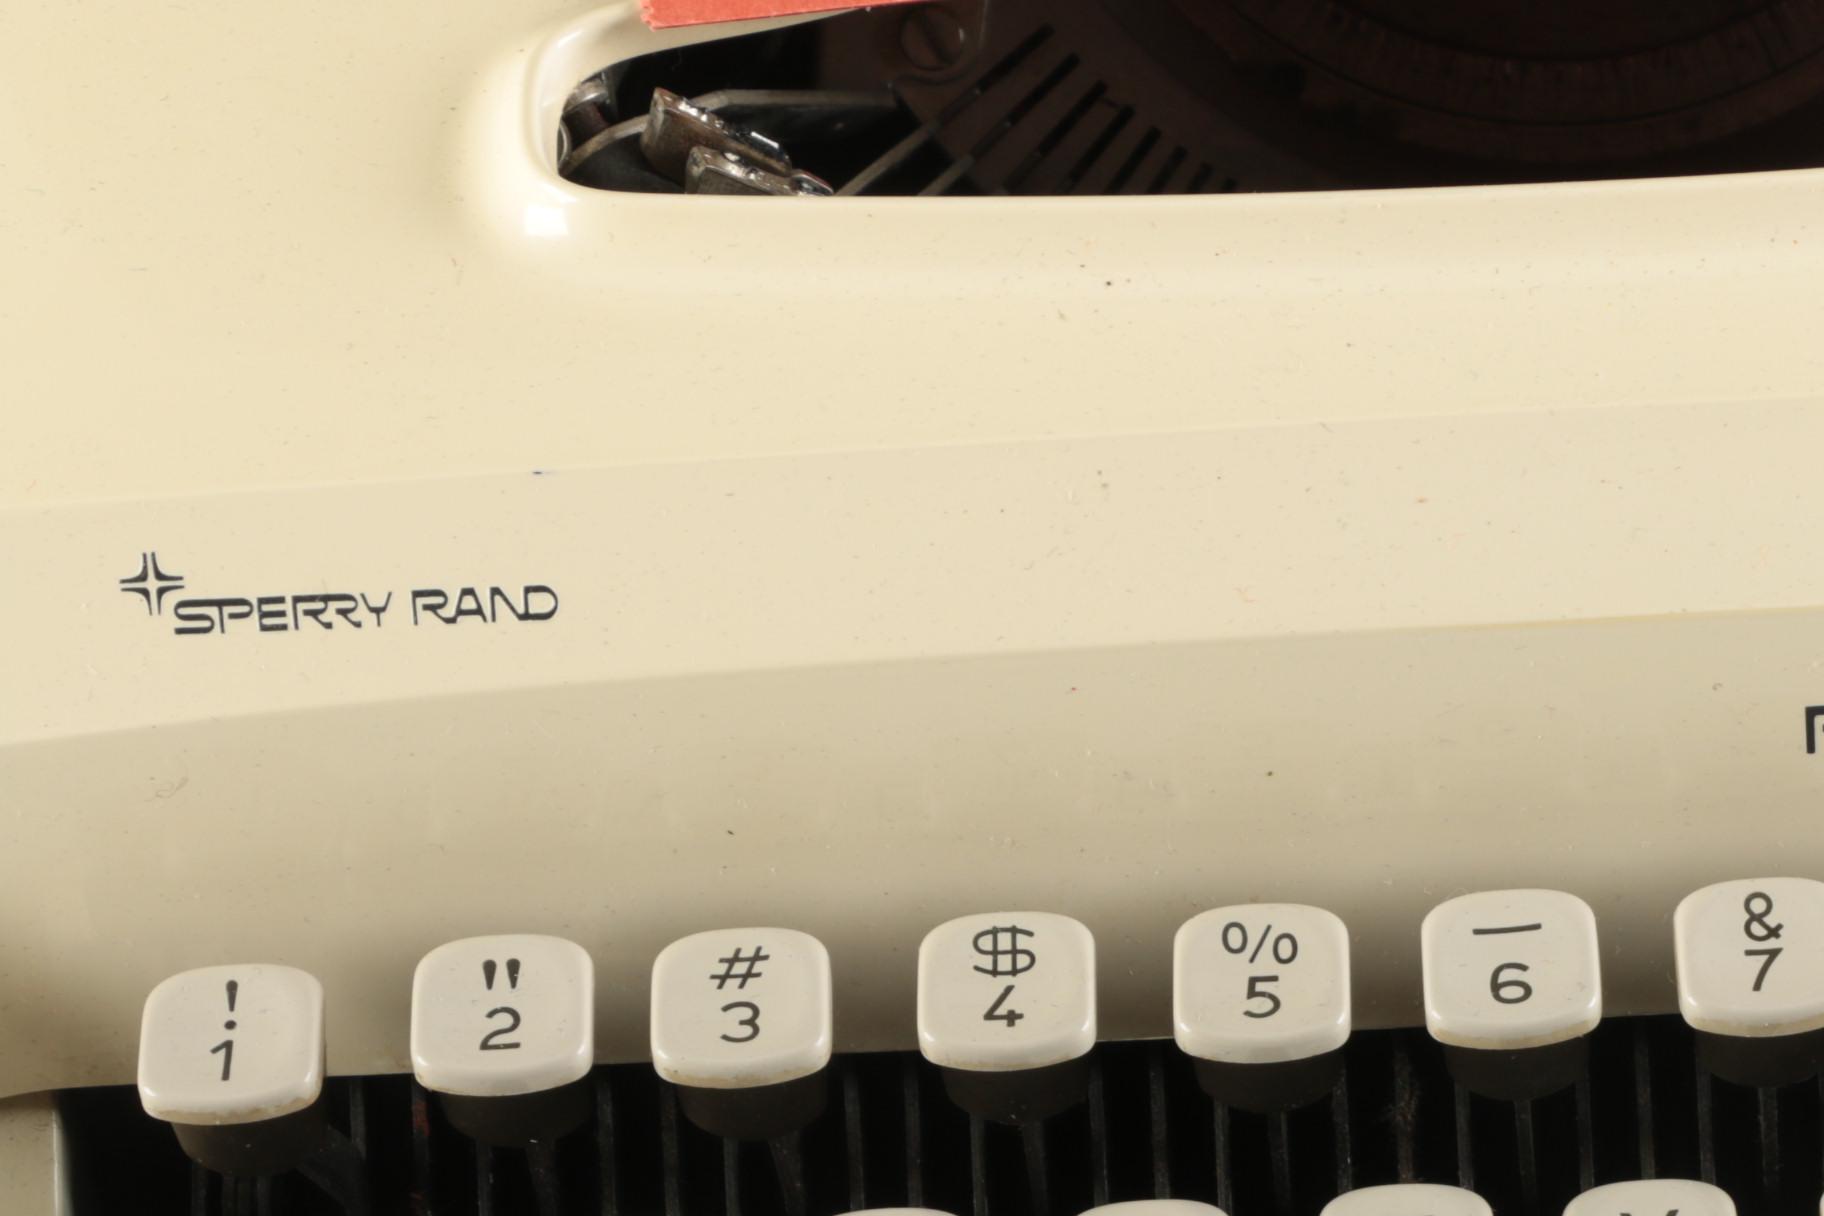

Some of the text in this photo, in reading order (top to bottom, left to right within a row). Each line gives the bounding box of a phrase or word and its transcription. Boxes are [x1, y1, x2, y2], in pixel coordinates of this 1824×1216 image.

[173, 585, 558, 635] SPERRY RAND
[1744, 892, 1784, 942] &
[972, 925, 1036, 978] $
[1221, 921, 1298, 965] %
[710, 946, 770, 990] #
[1490, 962, 1533, 1005] 6
[1744, 947, 1783, 992] 7
[224, 980, 238, 1030] !
[983, 984, 1024, 1028] 4
[1243, 975, 1281, 1019] 5
[479, 1006, 521, 1051] 2
[721, 1001, 760, 1043] 3
[211, 1039, 234, 1081] 1
